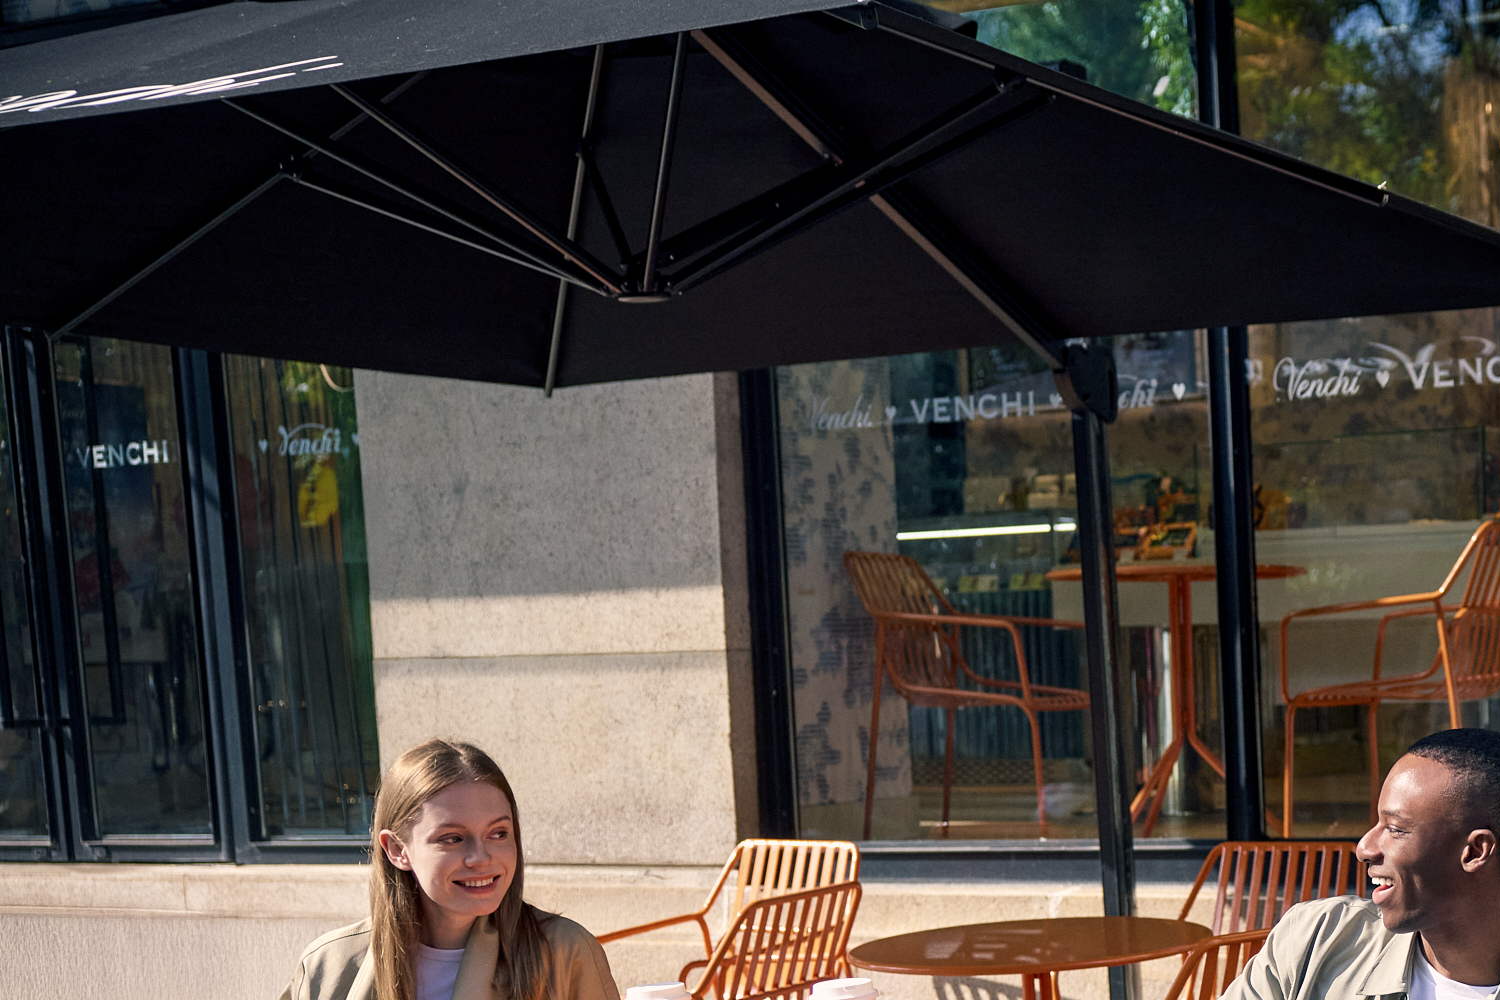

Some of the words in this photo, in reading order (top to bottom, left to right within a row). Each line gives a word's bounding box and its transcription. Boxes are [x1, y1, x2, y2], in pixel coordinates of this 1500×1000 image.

[1272, 356, 1363, 402] Venchi
[811, 393, 872, 432] Venchi
[909, 390, 1035, 424] VENCHI
[76, 439, 169, 469] VENCHI
[278, 422, 341, 457] Venchi
